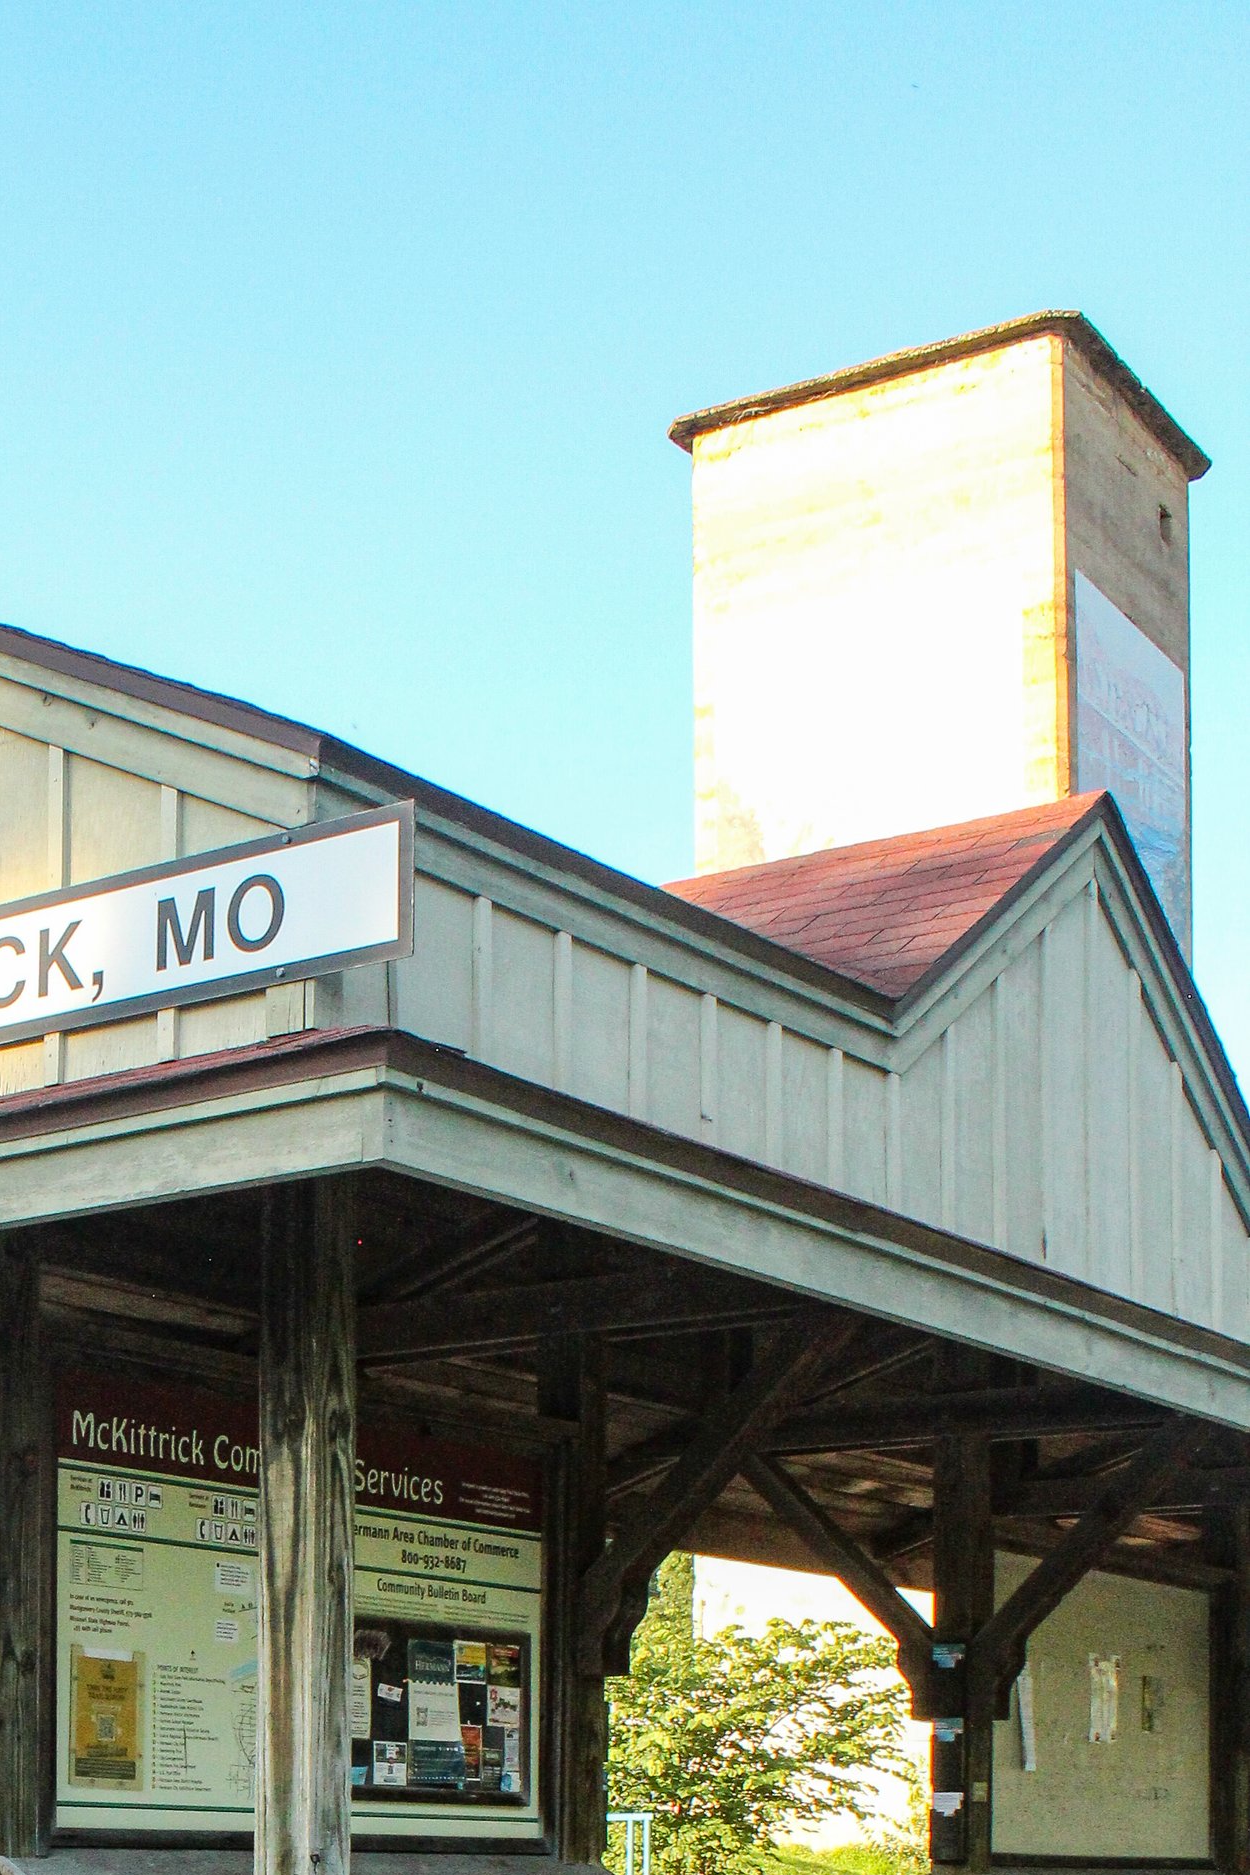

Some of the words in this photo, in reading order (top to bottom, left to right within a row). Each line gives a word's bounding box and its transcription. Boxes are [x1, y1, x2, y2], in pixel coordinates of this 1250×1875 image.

[156, 873, 285, 971] MO
[72, 1409, 205, 1466] McKittrick
[214, 1435, 261, 1474] Com
[355, 1459, 444, 1505] Services
[354, 1524, 390, 1541] ermann
[391, 1526, 415, 1544] Area
[417, 1530, 459, 1551] Chamber
[461, 1540, 472, 1551] of
[473, 1539, 519, 1559] Commerce
[401, 1549, 467, 1573] 800-932-8687
[377, 1578, 426, 1600] Community
[428, 1584, 459, 1602] Bulletin
[462, 1588, 486, 1604] Board
